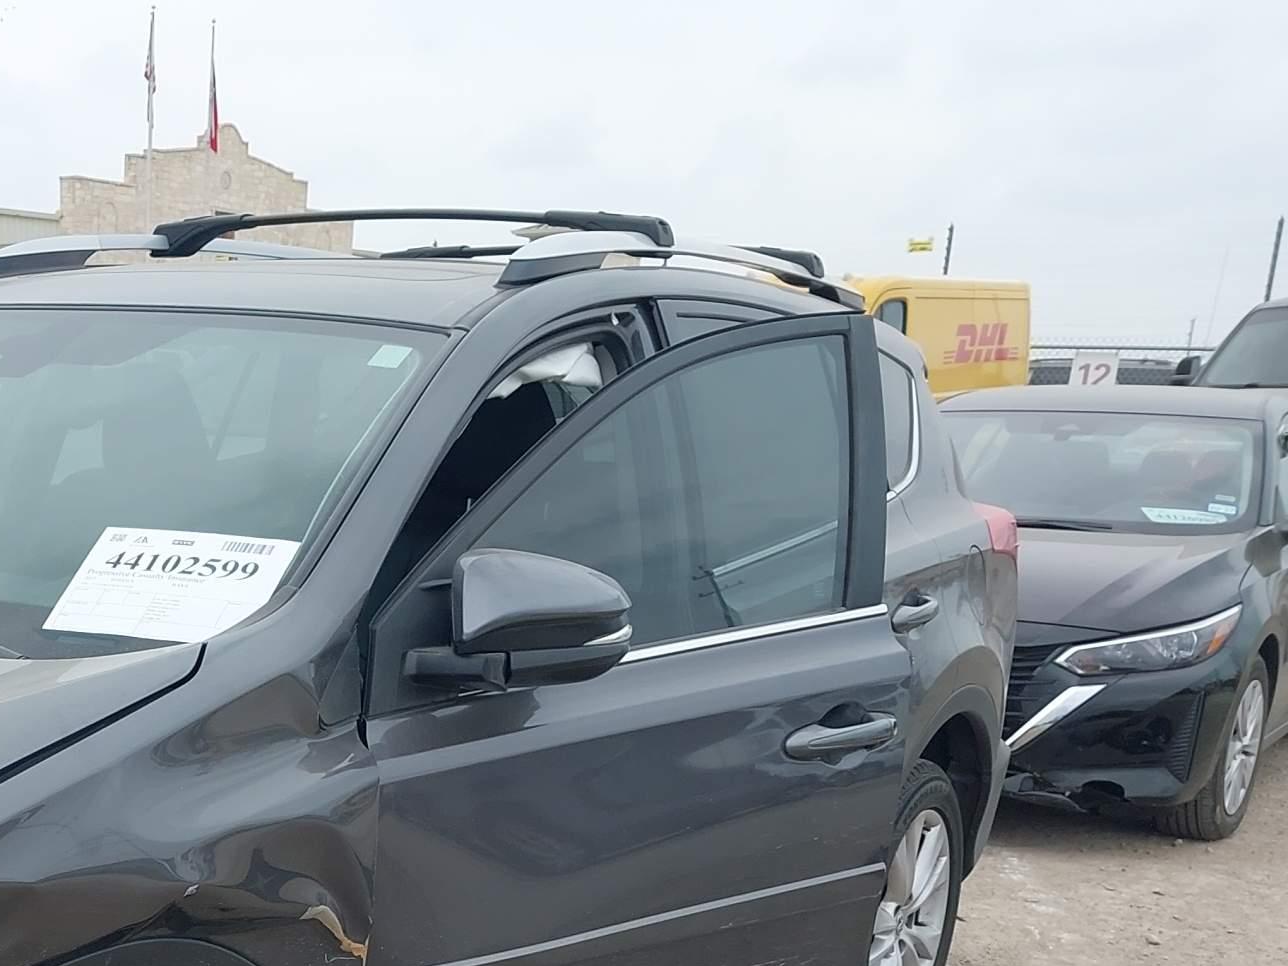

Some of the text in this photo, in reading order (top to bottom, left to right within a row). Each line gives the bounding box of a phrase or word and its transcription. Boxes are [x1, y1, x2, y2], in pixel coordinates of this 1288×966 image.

[954, 323, 1009, 363] DHL
[1078, 363, 1112, 385] 12
[105, 550, 260, 581] 44102599
